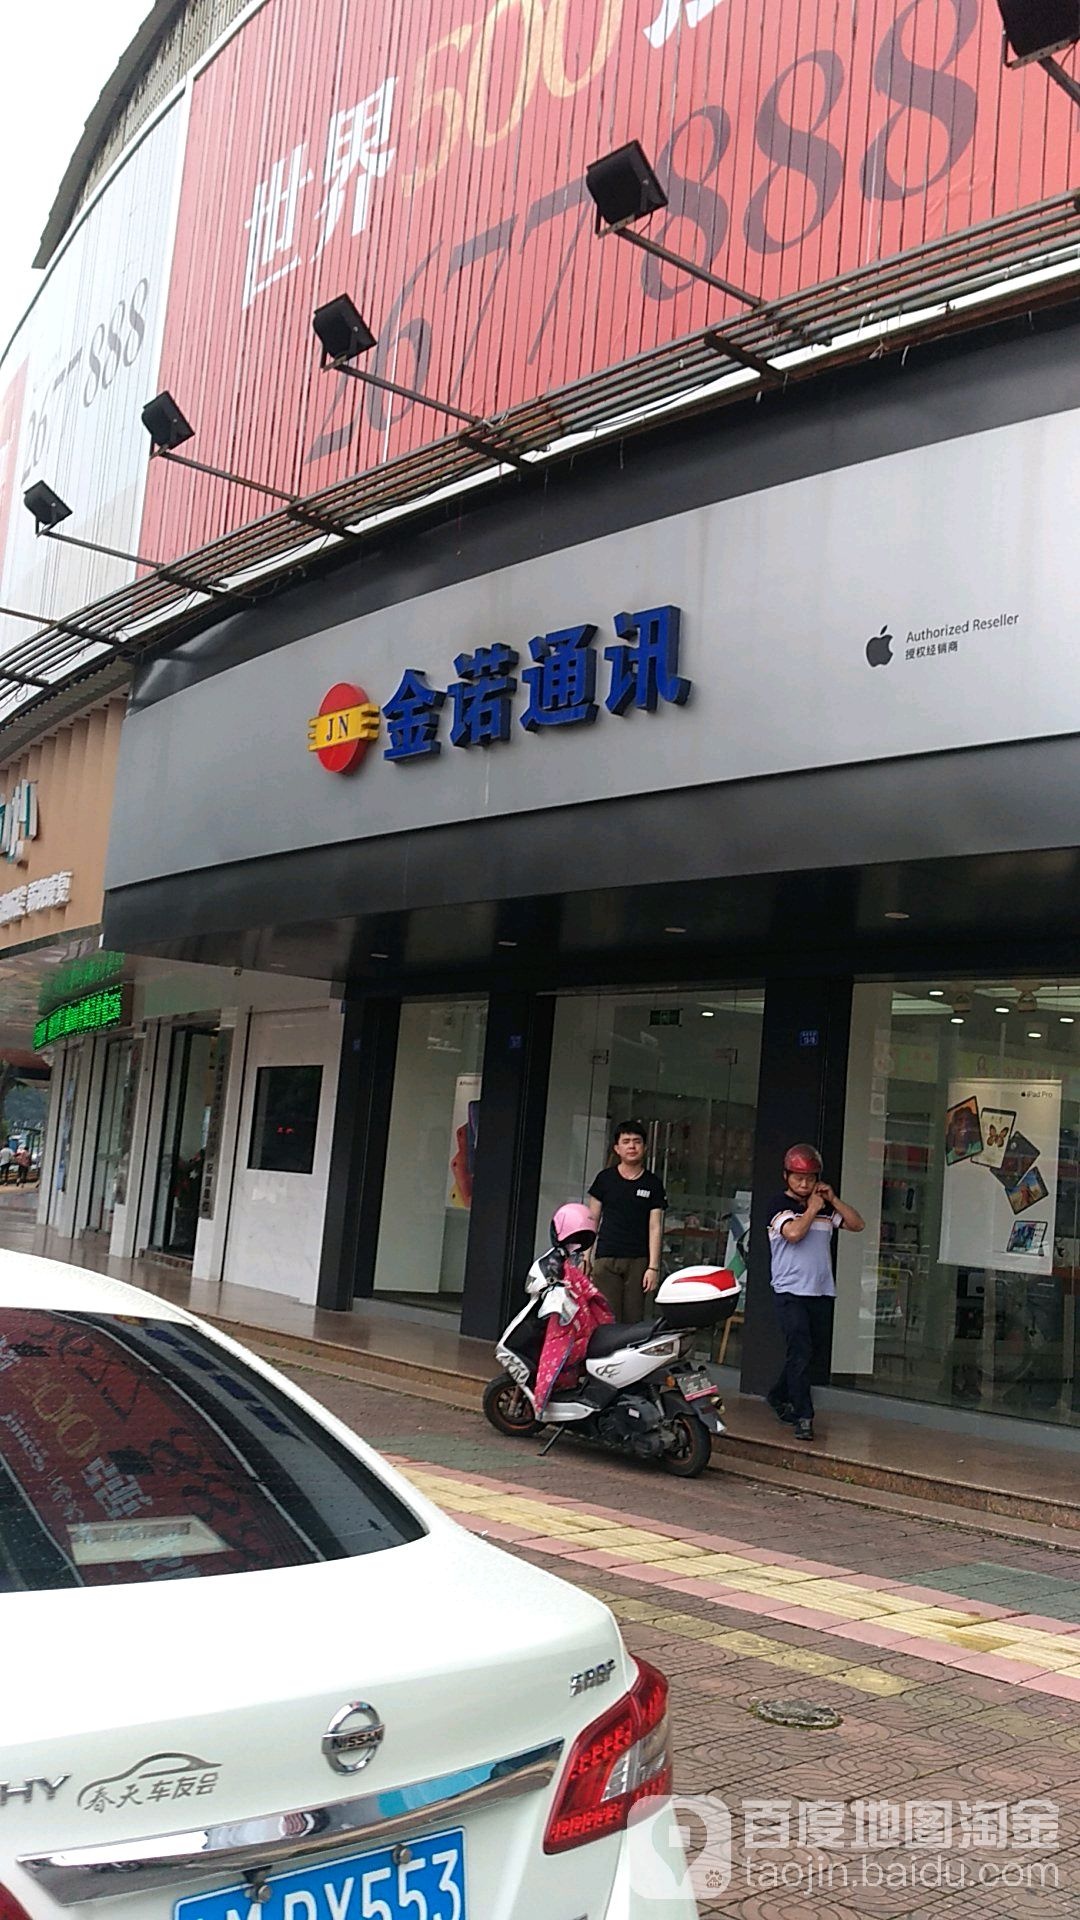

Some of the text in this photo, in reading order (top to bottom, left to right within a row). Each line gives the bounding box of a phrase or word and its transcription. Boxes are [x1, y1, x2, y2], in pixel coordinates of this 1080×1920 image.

[242, 0, 726, 310] 世界500
[906, 613, 1019, 643] Authorized Reseller
[905, 640, 959, 660] 授权经销商
[382, 604, 692, 763] 金诺通讯
[325, 713, 350, 741] JN
[1026, 1090, 1053, 1098] iPad Pro
[331, 1729, 384, 1751] NISSAN
[83, 1771, 219, 1813] 春天车友会
